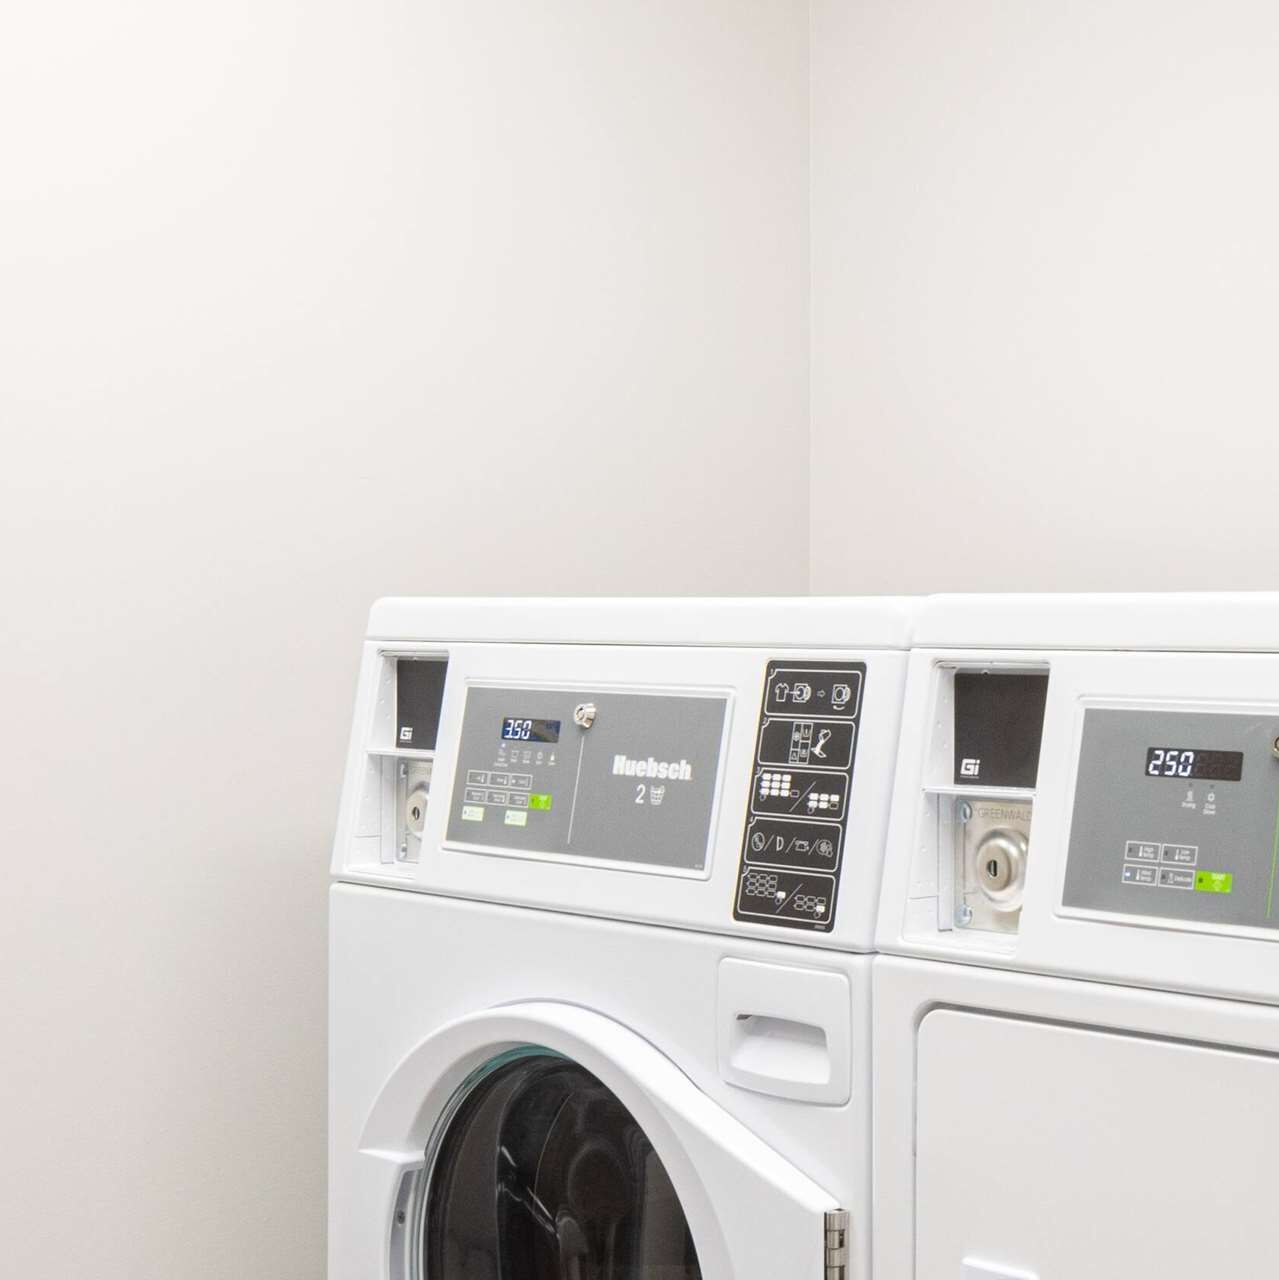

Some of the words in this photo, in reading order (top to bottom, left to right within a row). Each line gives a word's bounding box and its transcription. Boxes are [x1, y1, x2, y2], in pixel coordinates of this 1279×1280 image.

[612, 754, 692, 781] Huebsch
[960, 758, 981, 776] Gi
[635, 784, 646, 804] 2
